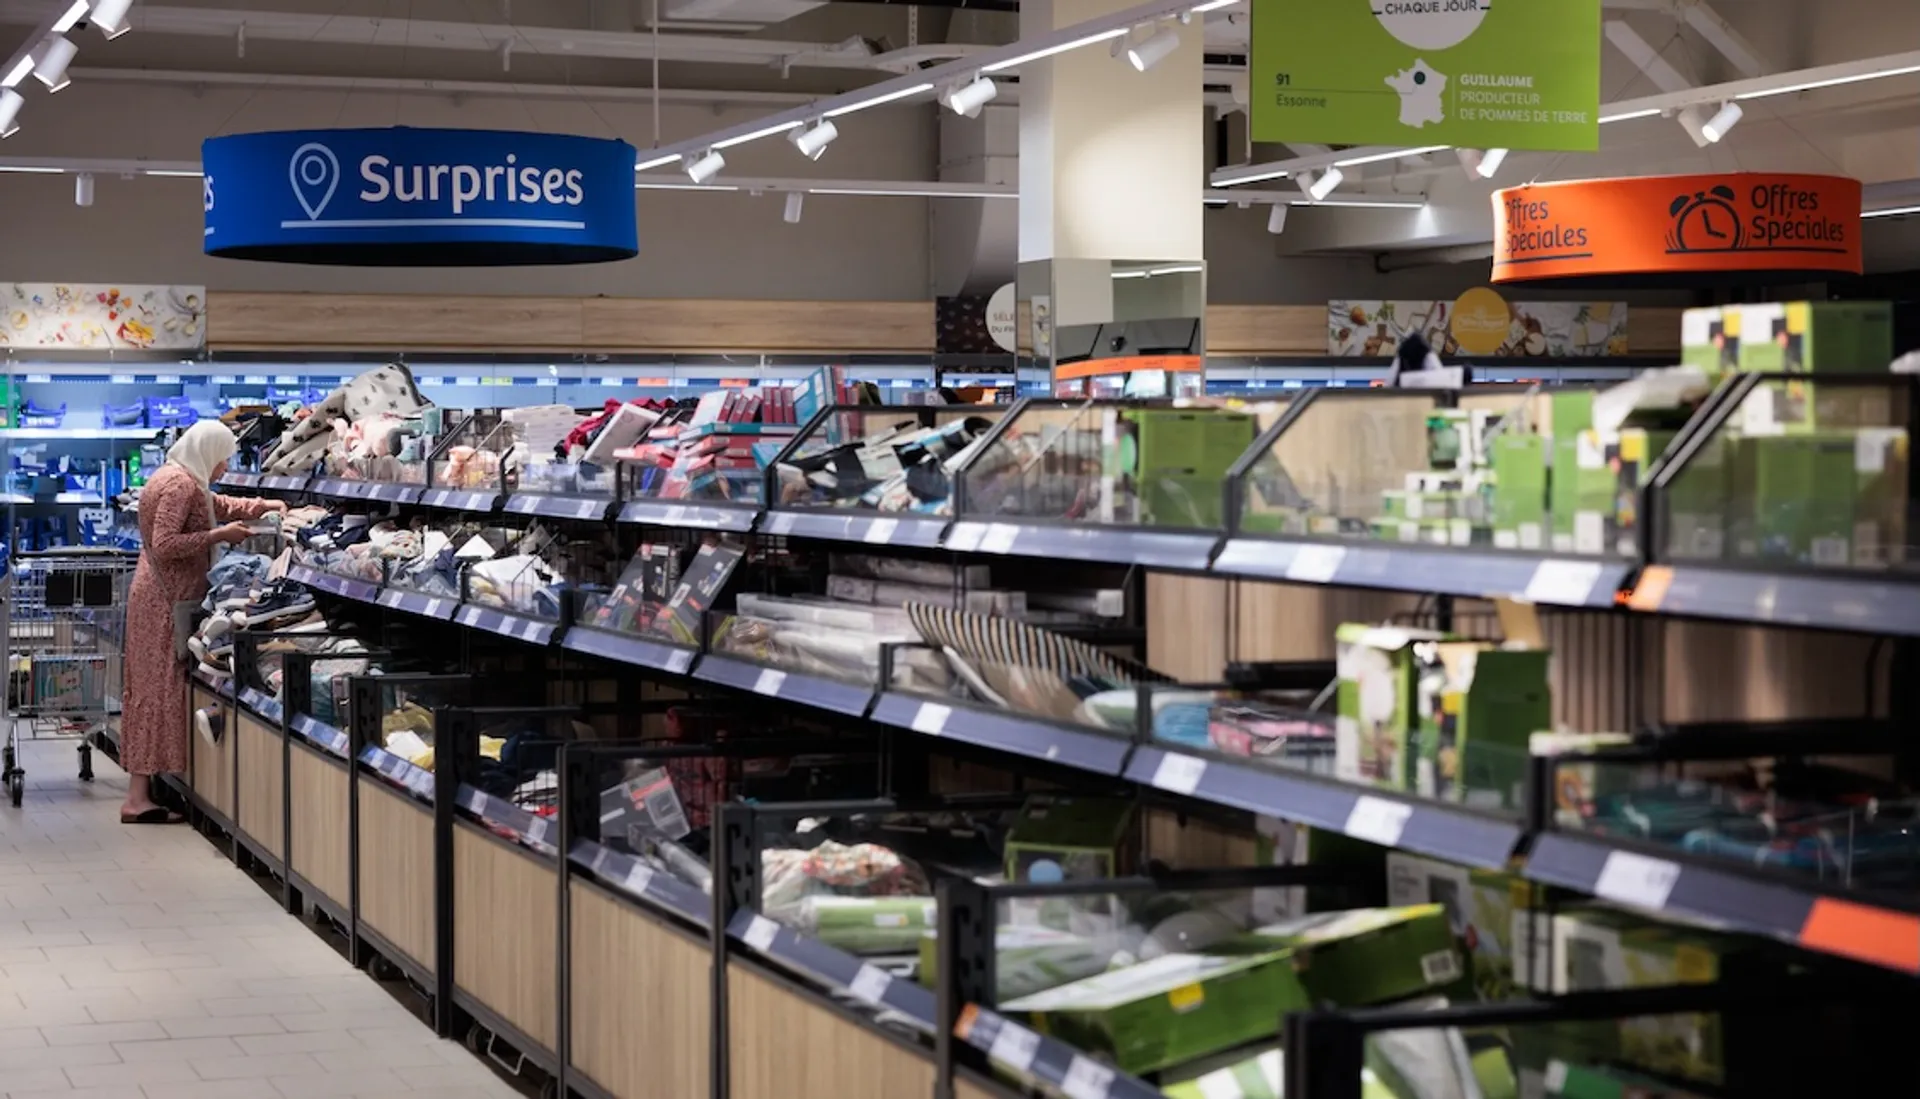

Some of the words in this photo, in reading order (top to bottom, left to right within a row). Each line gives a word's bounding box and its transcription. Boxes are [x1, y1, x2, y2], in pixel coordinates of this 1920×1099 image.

[1385, 2, 1440, 15] CHAQUE
[1443, 0, 1477, 12] JOUR
[1276, 73, 1290, 86] 91
[1460, 74, 1533, 88] GUILLAUME
[1276, 93, 1327, 108] Essonne
[1460, 91, 1541, 105] PRODUCTEUR
[1460, 108, 1476, 120] DE
[1478, 108, 1531, 122] POMMES
[1534, 110, 1549, 122] DE
[1552, 111, 1588, 124] TERRE
[360, 153, 584, 214] Surprises
[1751, 184, 1818, 217] Offres
[1752, 211, 1844, 247] Spéciales
